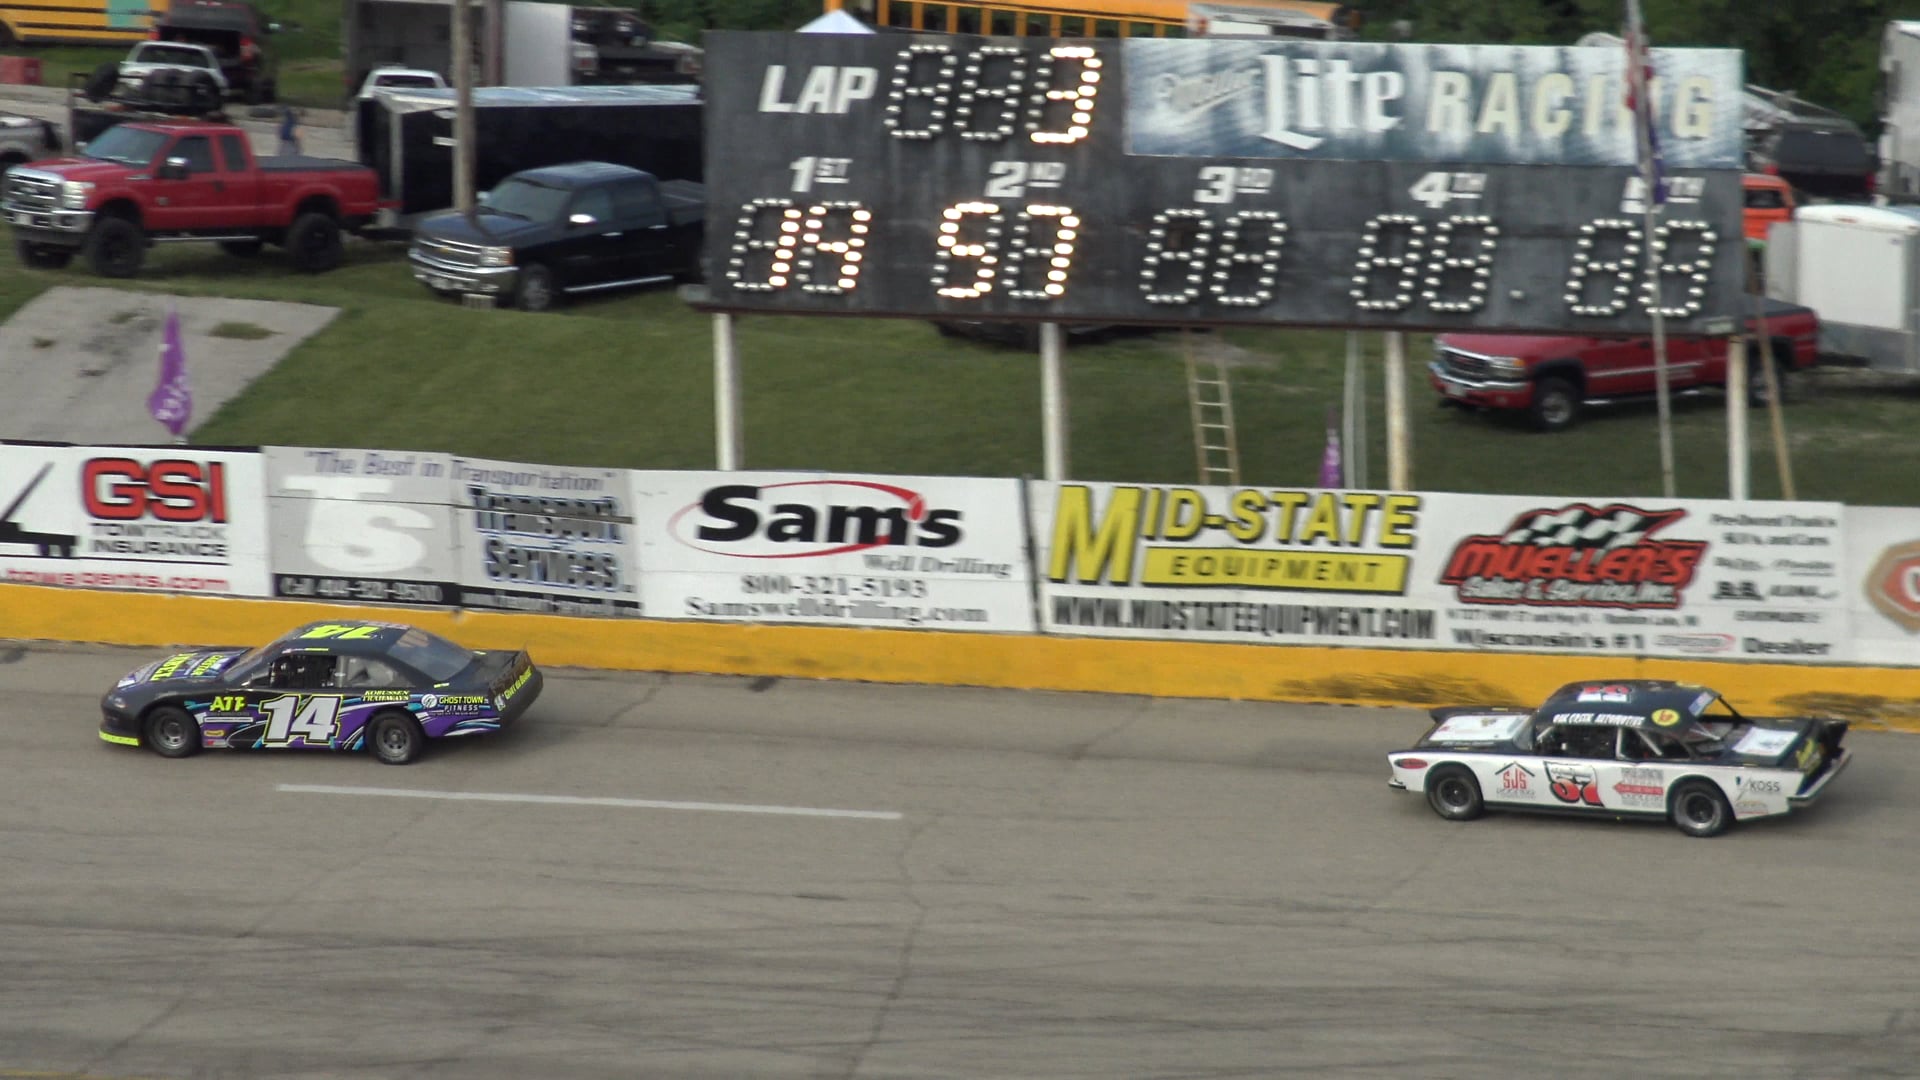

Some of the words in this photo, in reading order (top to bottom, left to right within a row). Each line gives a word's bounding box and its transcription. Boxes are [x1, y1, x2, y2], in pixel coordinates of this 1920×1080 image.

[758, 65, 878, 114] LAP
[1257, 54, 1403, 150] Lite
[789, 157, 853, 192] 1ST
[984, 162, 1067, 198] 2ND
[1194, 166, 1275, 203] 3RD
[1409, 171, 1488, 208] 4TH
[82, 457, 229, 524] GSI
[696, 485, 964, 548] Sam's
[91, 539, 229, 558] INSURANCE
[1048, 484, 1420, 586] MID-STATE
[864, 554, 917, 572] Well
[921, 557, 1012, 578] Drilling
[1170, 555, 1382, 584] EQUIPMENT
[1446, 544, 1697, 582] MUELLER'S
[741, 574, 928, 600] 800-321-5193
[1460, 576, 1525, 599] Sales
[1453, 628, 1607, 650] Wisconsin's
[1743, 636, 1833, 656] Dealer
[209, 696, 246, 712] ATF
[439, 695, 462, 705] GHOST
[463, 695, 484, 705] TOWN
[443, 704, 479, 712] FITNESS
[258, 694, 342, 745] 14
[1503, 767, 1528, 790] SJS
